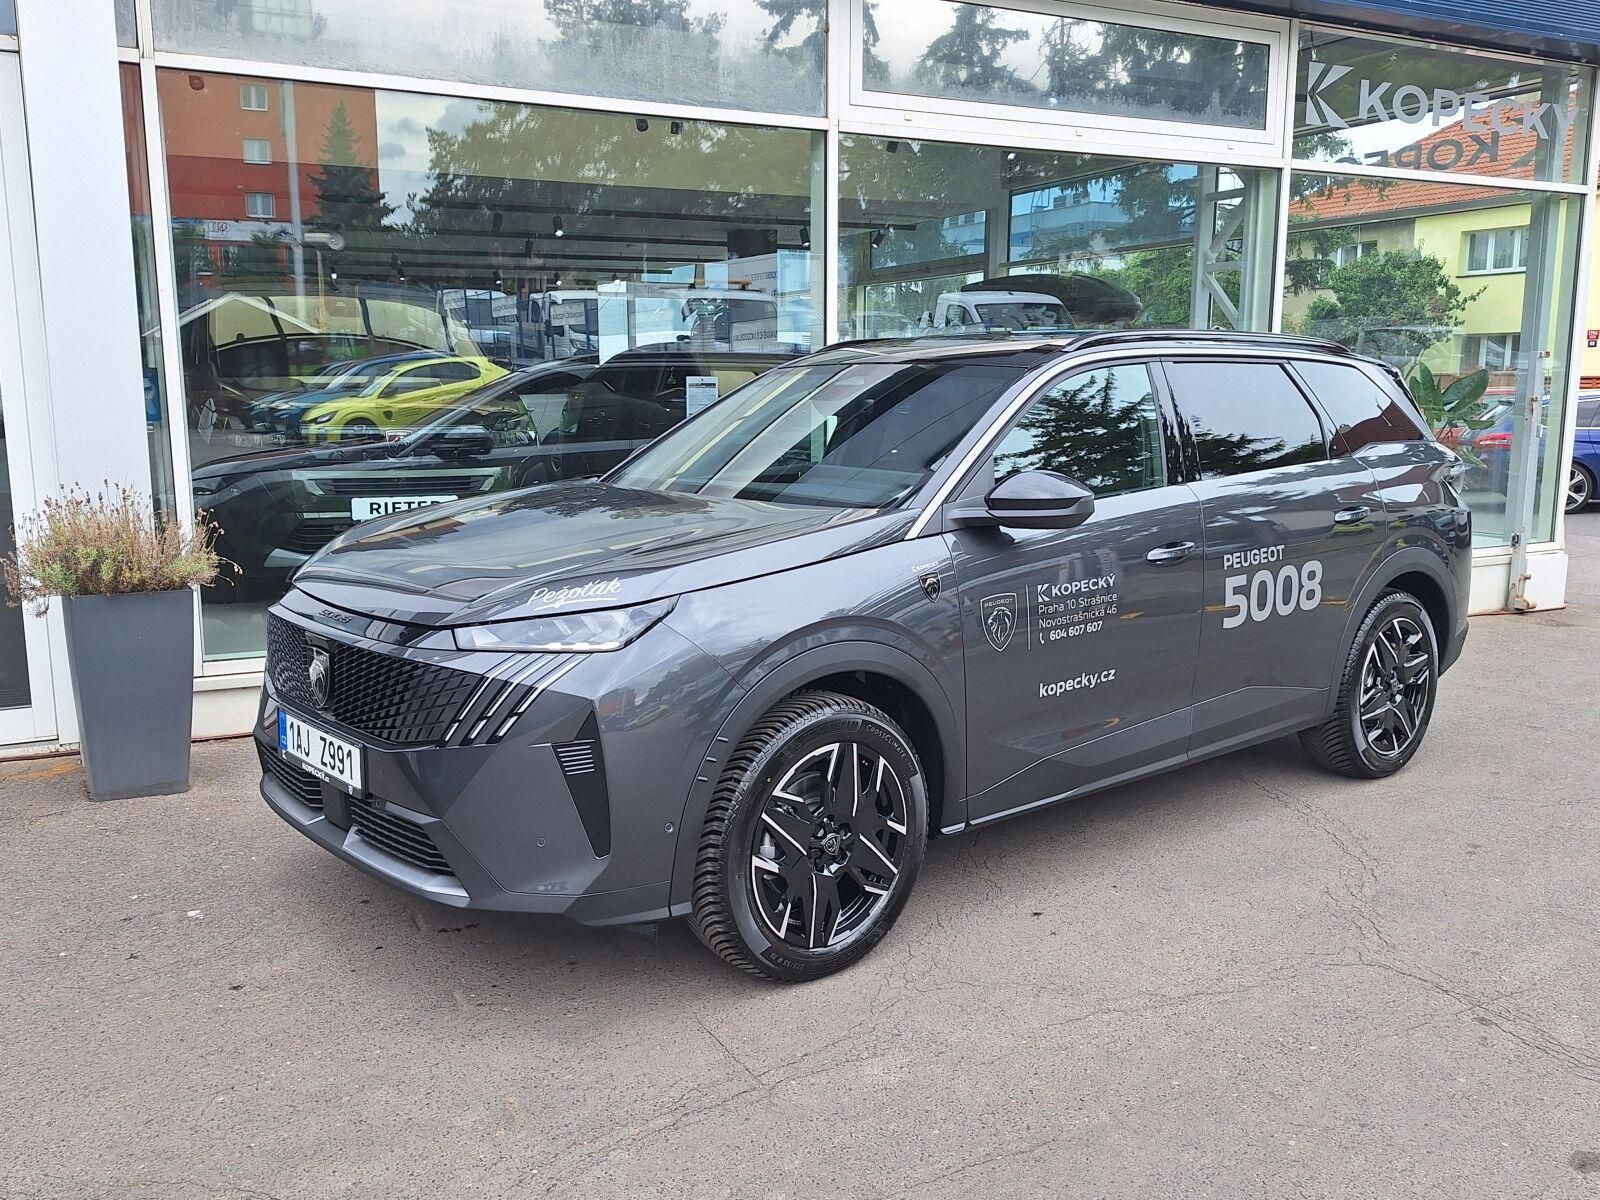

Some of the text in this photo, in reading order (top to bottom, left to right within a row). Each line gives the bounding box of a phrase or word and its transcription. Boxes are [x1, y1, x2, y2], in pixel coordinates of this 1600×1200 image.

[1223, 544, 1285, 571] PEUGEOT
[1051, 573, 1116, 597] KOPECKÝ
[1222, 560, 1323, 629] 5008
[984, 598, 1013, 608] PEUGEOT
[1038, 592, 1118, 615] Praha 10 Strašnice
[1038, 603, 1118, 629] Novostrašnická 46
[1049, 620, 1103, 641] 604 607 607
[1039, 668, 1117, 697] kopecky.cz
[289, 720, 354, 781] 1AJ Z991
